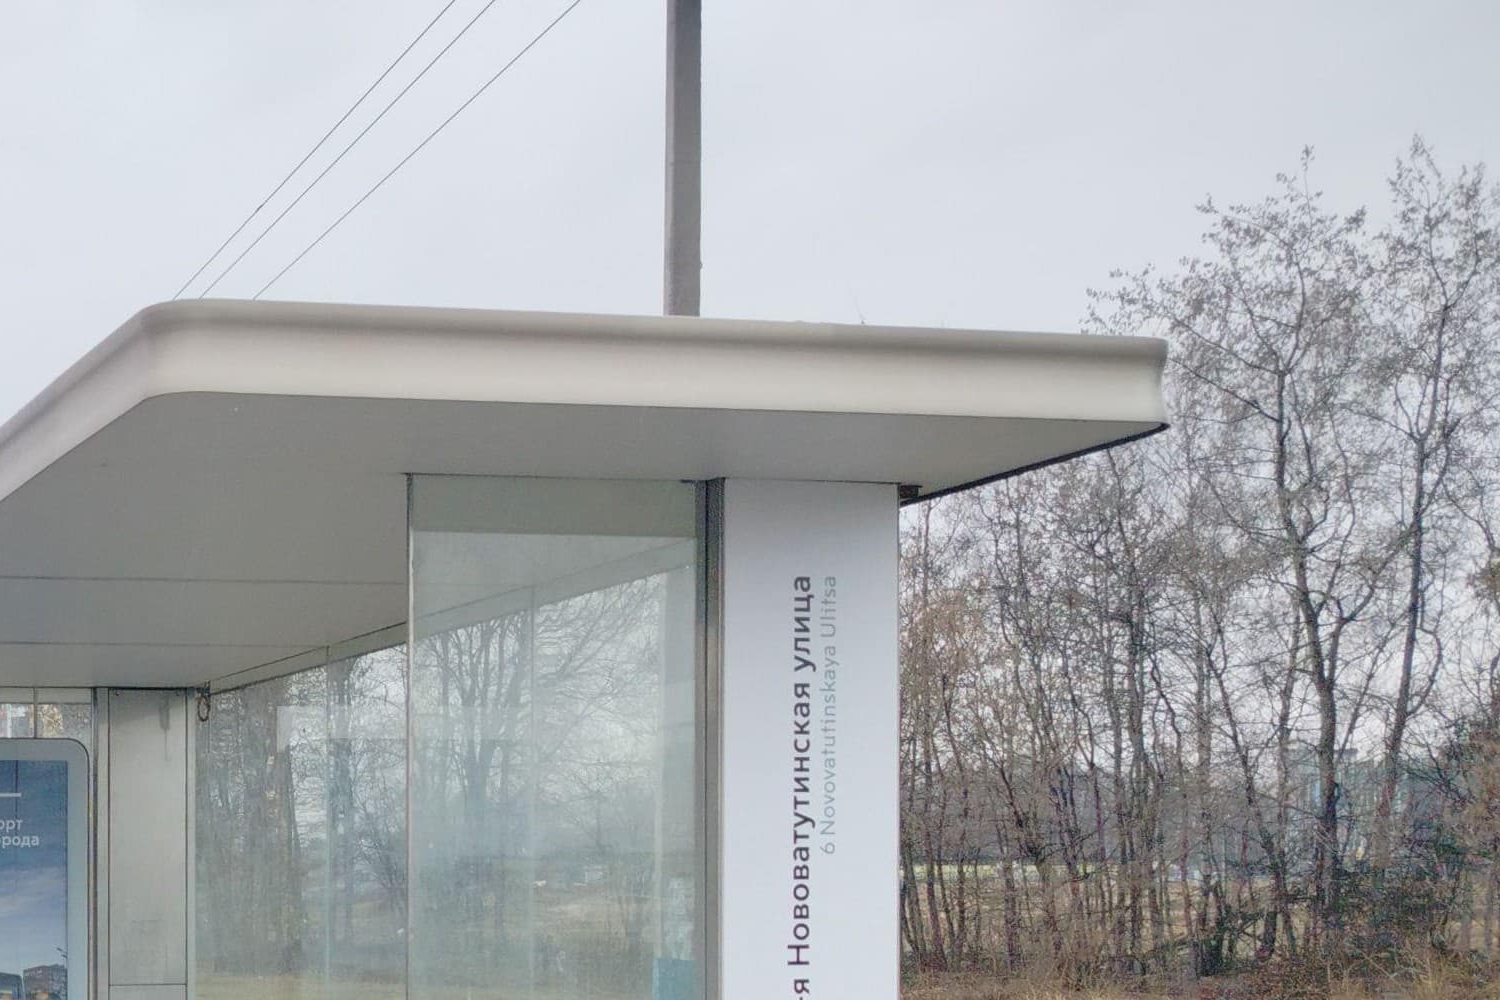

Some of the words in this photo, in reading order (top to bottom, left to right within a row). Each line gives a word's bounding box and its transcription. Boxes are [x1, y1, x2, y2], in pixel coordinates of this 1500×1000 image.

[793, 576, 816, 672] улица
[819, 576, 836, 638] Ulitsa
[819, 645, 840, 835] Novovatutinskaya
[787, 682, 815, 965] Нововатутинская
[819, 842, 836, 854] 6
